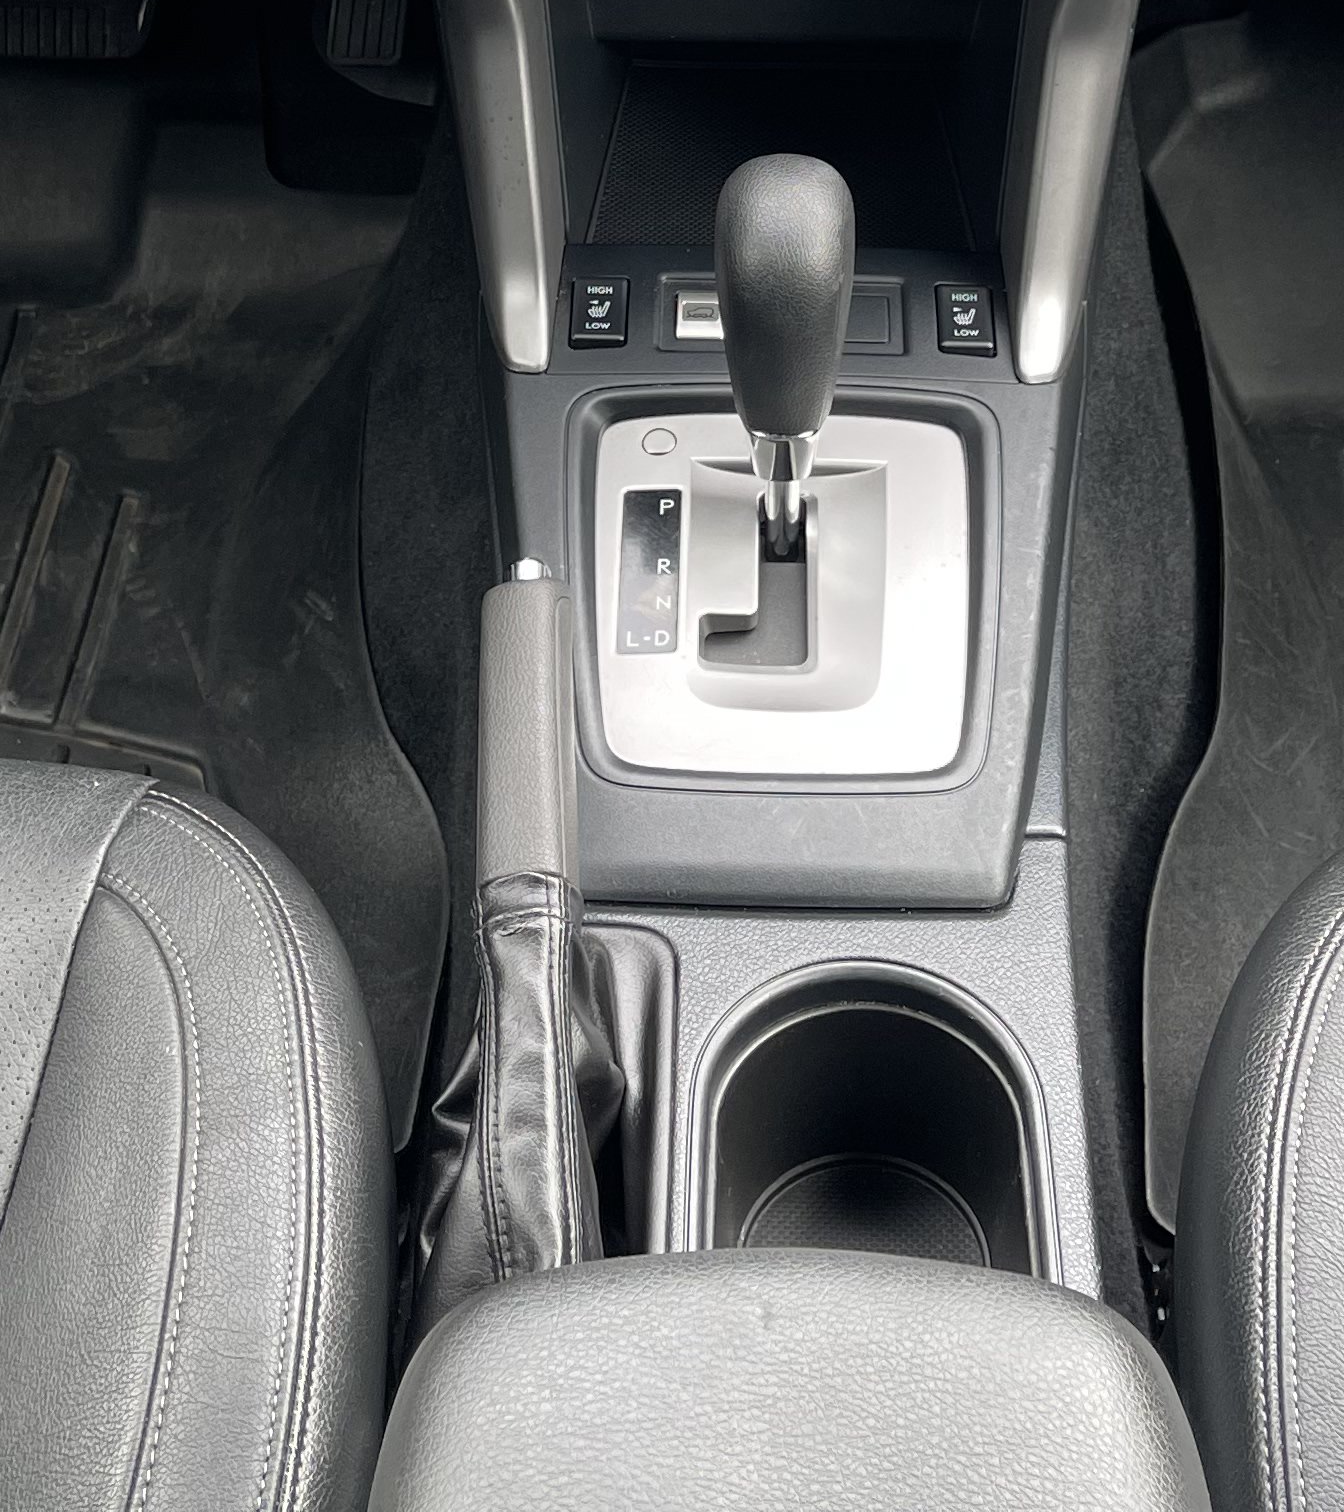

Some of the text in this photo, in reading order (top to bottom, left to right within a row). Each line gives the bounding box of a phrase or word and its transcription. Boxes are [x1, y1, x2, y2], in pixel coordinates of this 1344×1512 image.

[586, 285, 614, 295] HIGH
[951, 293, 978, 302] HIGH
[585, 321, 611, 330] LOW
[953, 328, 980, 337] LOW
[659, 498, 675, 516] P
[656, 557, 672, 575] R
[656, 595, 672, 610] N
